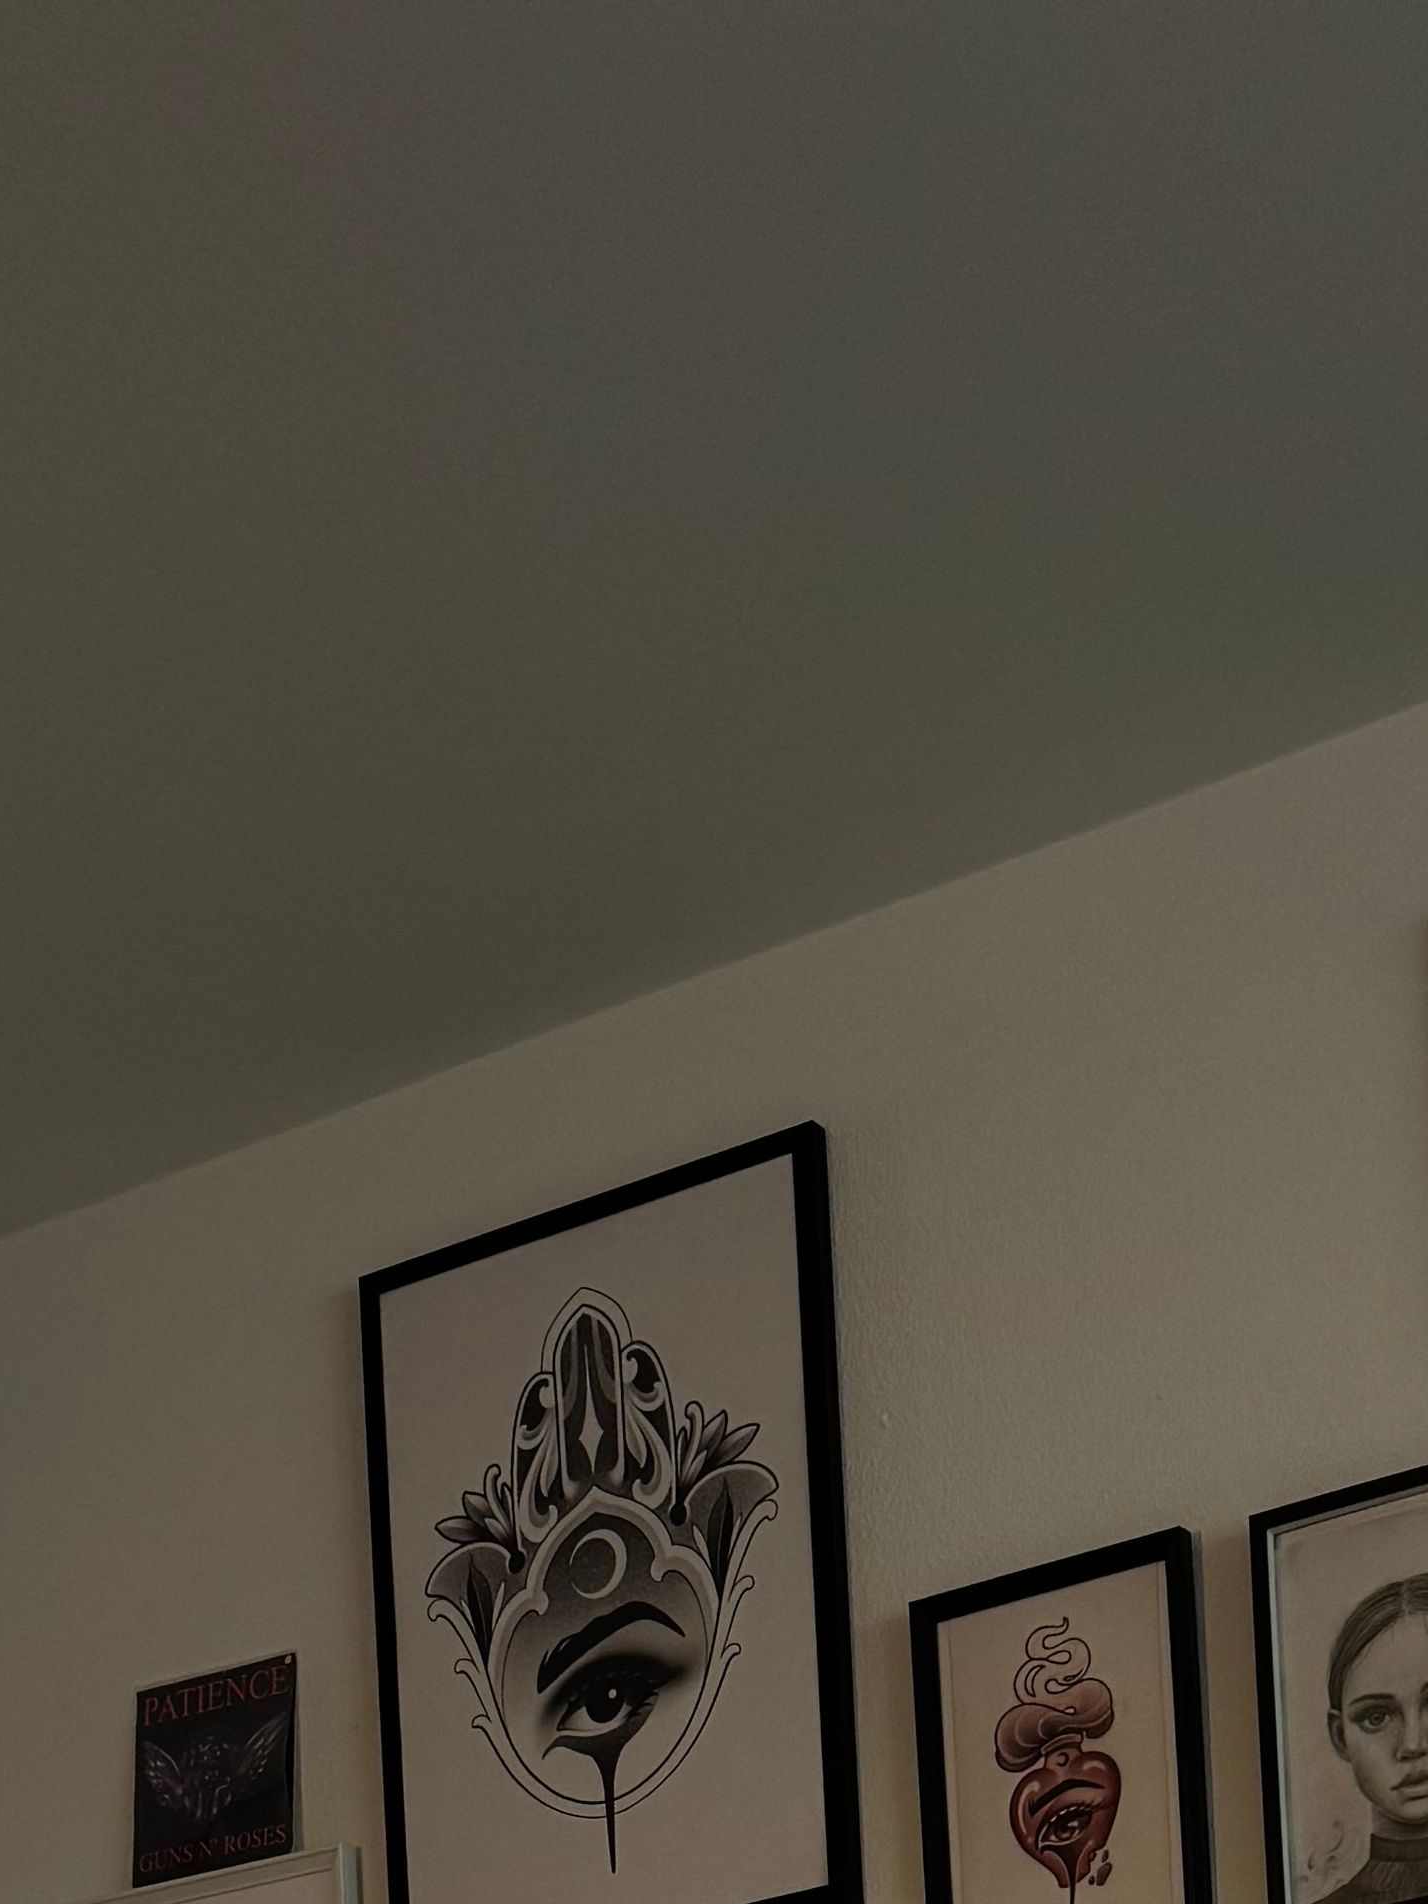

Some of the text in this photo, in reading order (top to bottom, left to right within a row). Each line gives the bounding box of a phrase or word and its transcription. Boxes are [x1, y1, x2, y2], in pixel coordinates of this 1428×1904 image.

[142, 1665, 290, 1728] PATIENCE
[139, 1842, 194, 1873] GUNS
[222, 1824, 287, 1857] ROSES
